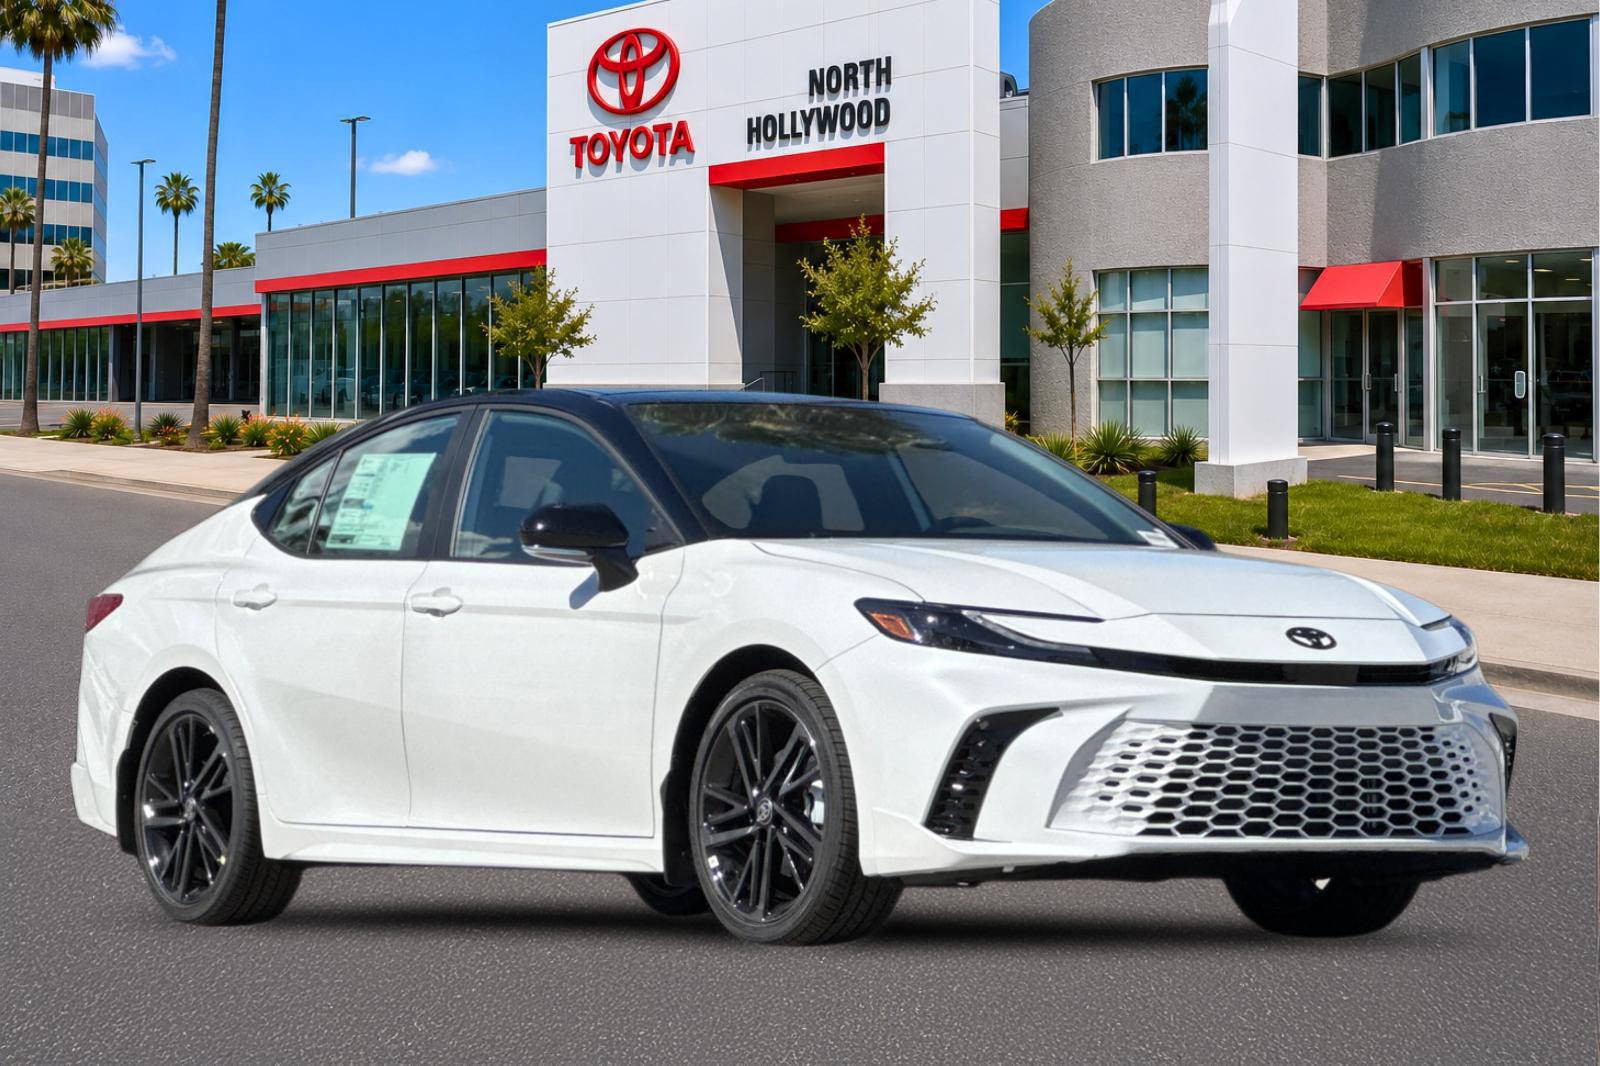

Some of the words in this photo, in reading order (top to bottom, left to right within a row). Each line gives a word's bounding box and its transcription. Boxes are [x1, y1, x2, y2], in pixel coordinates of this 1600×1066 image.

[808, 56, 891, 96] NORTH
[569, 120, 695, 168] TOYOTA
[747, 97, 890, 145] HOLLYWOOD
